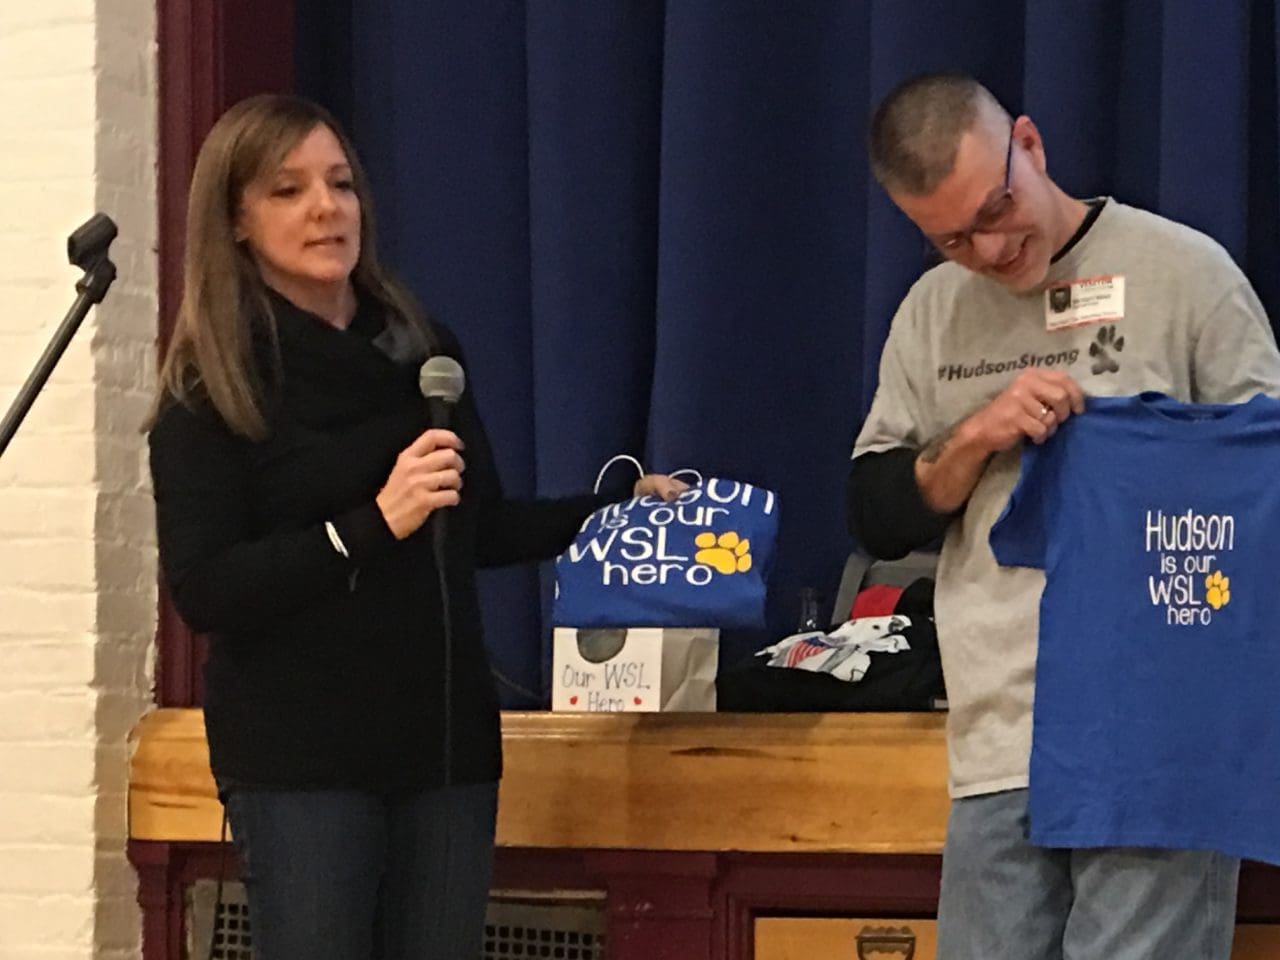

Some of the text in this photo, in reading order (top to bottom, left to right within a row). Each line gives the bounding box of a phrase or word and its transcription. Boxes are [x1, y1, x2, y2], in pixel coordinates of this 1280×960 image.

[938, 348, 1080, 381] #HudsonStrong
[648, 505, 730, 527] our
[1145, 507, 1235, 552] Hudson
[569, 526, 689, 563] WSL
[602, 560, 713, 586] hero
[1160, 552, 1217, 574] is our
[1148, 574, 1202, 606] WSL
[1167, 604, 1212, 626] hero
[562, 661, 651, 690] Our WSL
[587, 690, 626, 712] Hero
